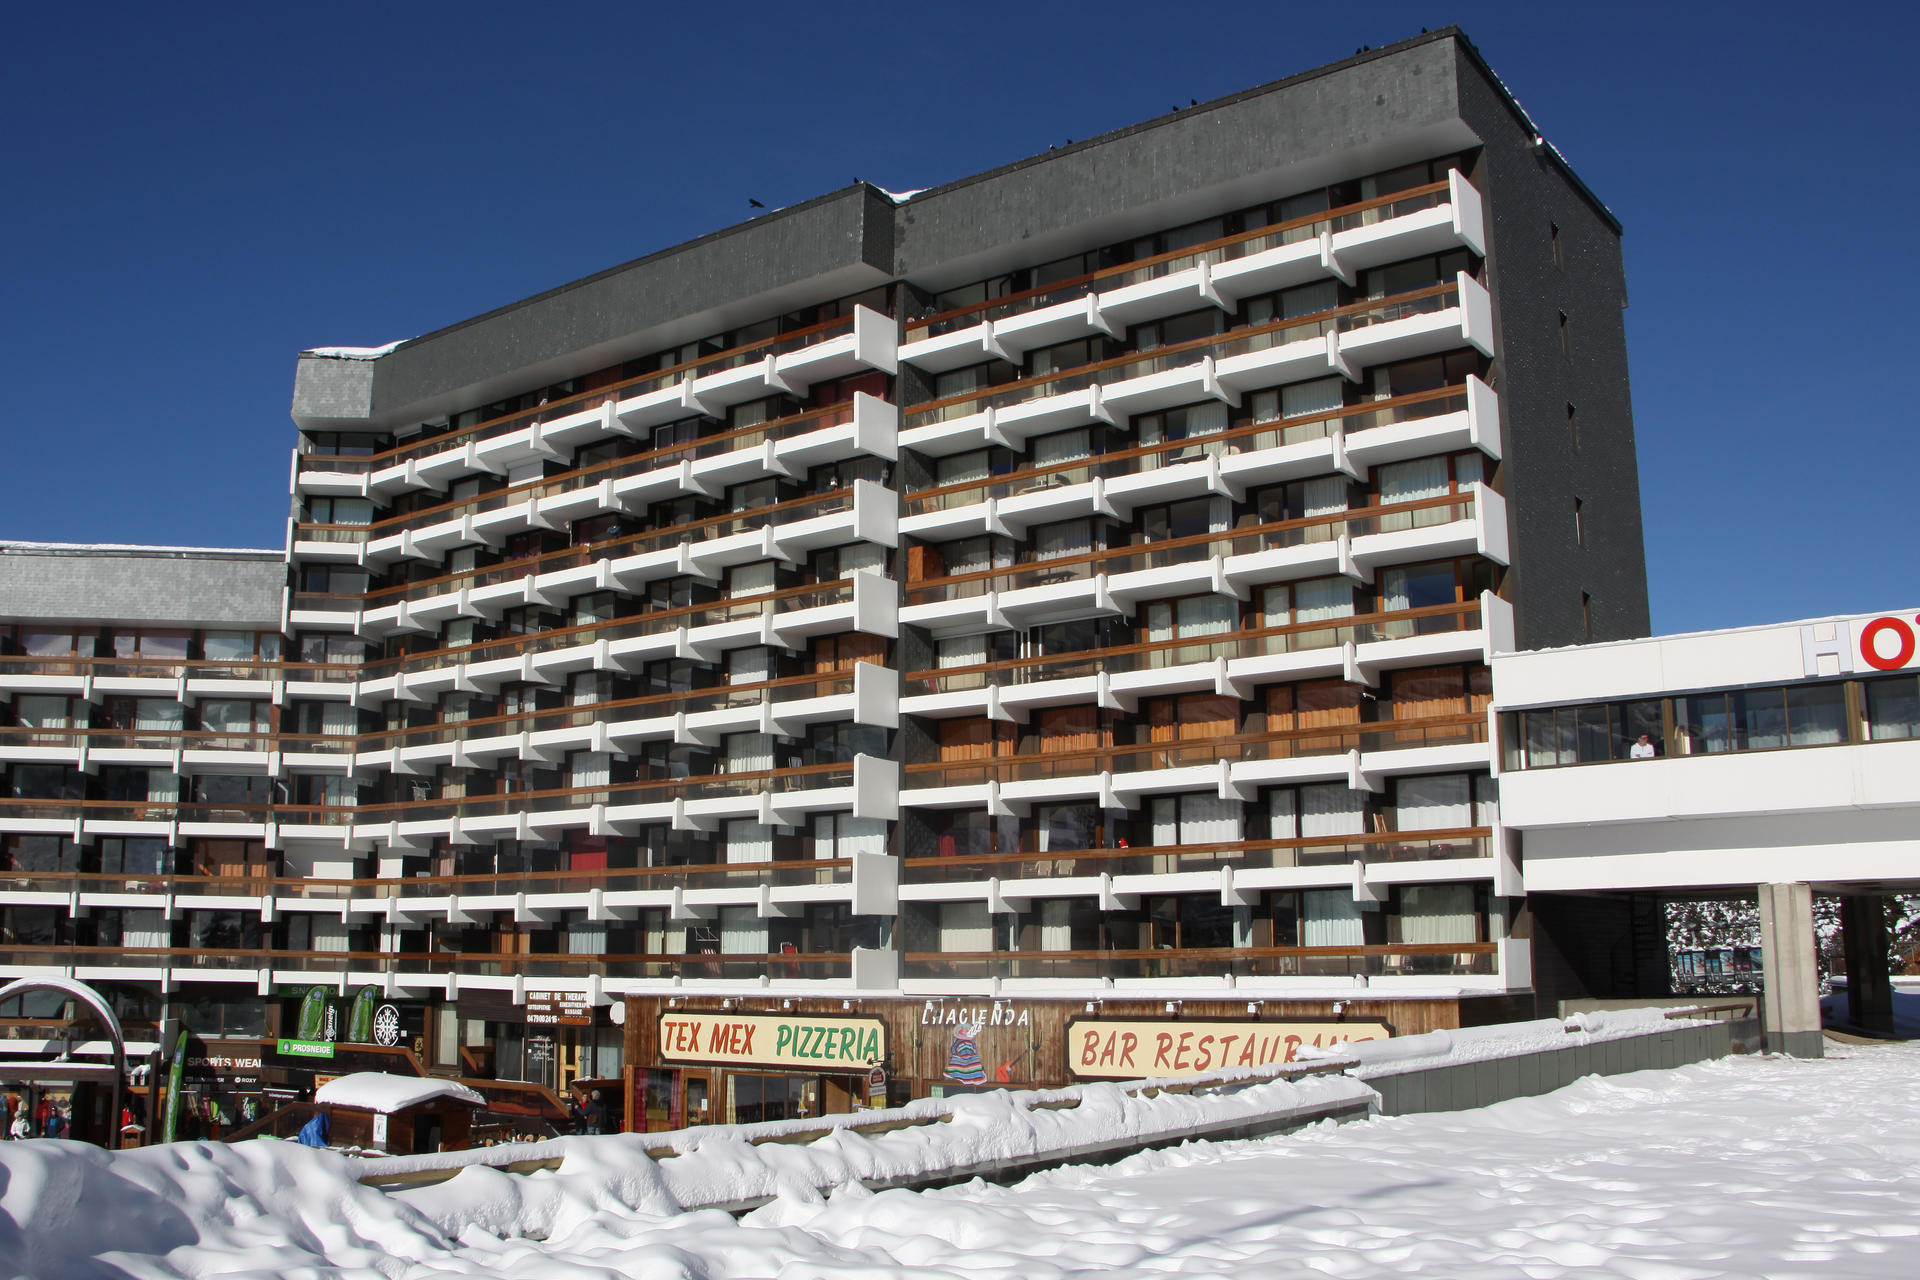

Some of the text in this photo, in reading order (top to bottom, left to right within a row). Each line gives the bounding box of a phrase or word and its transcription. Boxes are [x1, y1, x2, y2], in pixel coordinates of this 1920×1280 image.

[292, 1044, 331, 1054] PROSNEIGE
[664, 1022, 879, 1062] TEX MEX PIZZERIA
[1081, 1030, 1375, 1072] BAR RESTAUR
[187, 1057, 231, 1067] SPORTS
